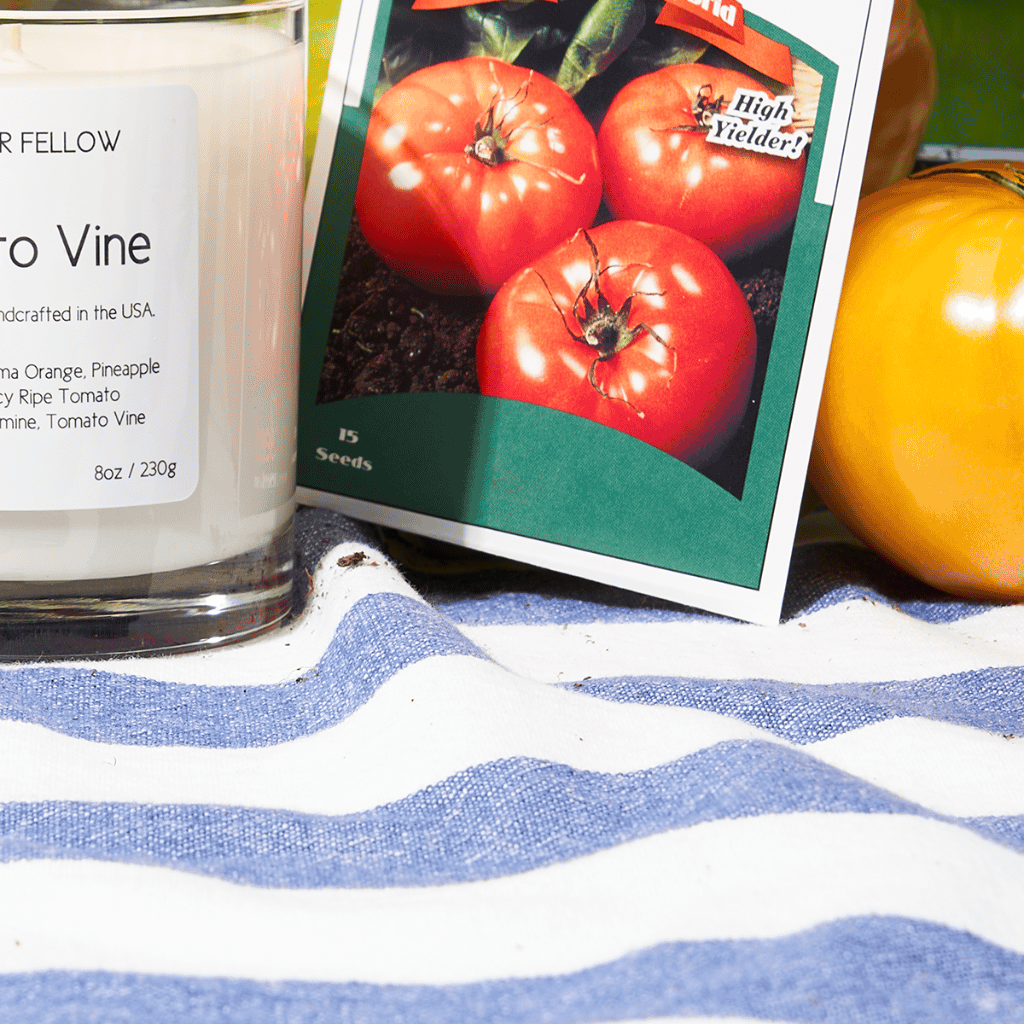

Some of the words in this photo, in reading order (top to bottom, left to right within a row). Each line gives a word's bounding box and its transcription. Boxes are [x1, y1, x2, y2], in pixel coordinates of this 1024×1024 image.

[734, 93, 789, 122] High
[20, 129, 122, 154] FELLOW
[713, 119, 805, 154] Yielder!
[56, 223, 152, 268] Vine
[76, 305, 89, 322] in
[93, 304, 118, 321] the
[121, 301, 156, 320] USA.
[24, 363, 87, 383] Orange,
[91, 357, 161, 380] Pineapple
[19, 388, 53, 409] Ripe
[58, 386, 121, 404] Tomato
[45, 412, 109, 430] Tomato
[113, 409, 146, 427] Vine
[338, 427, 359, 444] 15
[94, 464, 123, 482] 8oz
[127, 461, 136, 480] /
[140, 459, 177, 479] 230g
[315, 446, 373, 472] Seeds
